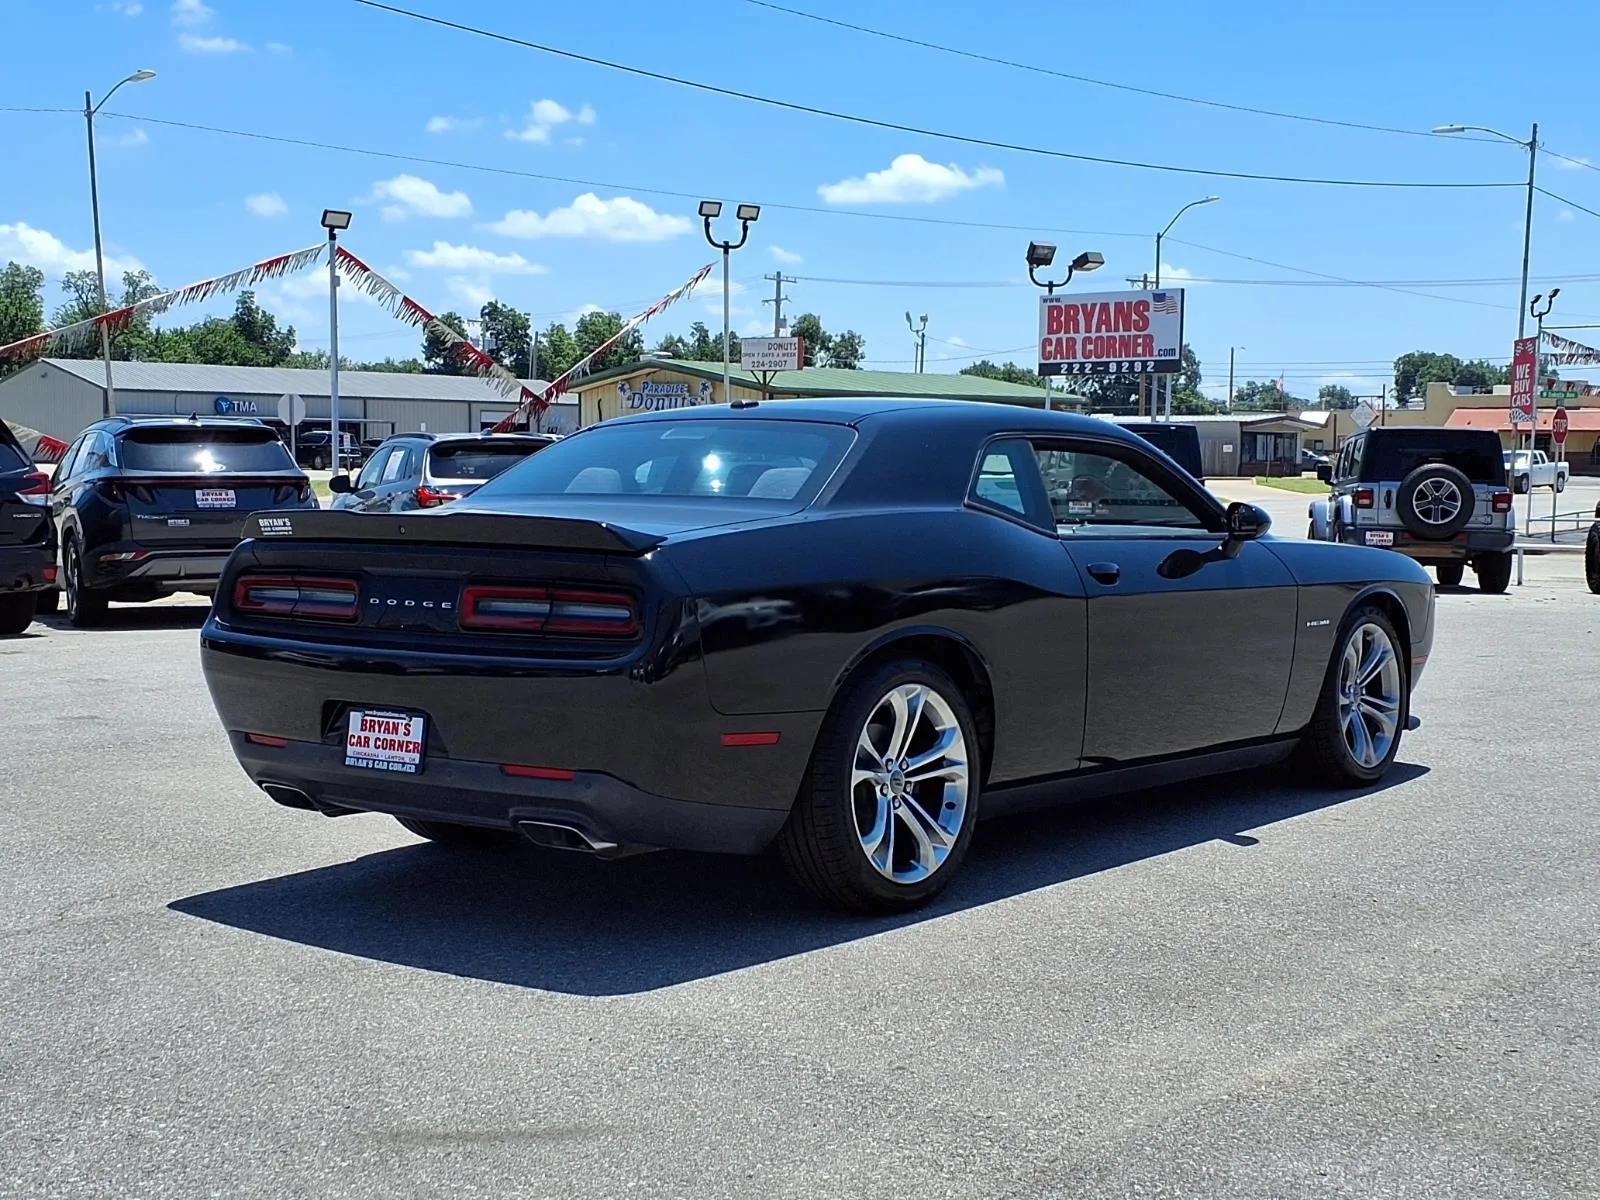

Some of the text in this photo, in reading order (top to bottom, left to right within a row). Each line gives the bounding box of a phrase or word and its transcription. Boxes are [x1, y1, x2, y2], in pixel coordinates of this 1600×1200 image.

[1047, 300, 1150, 335] BRYANS
[767, 342, 797, 350] DONUTS
[1041, 334, 1176, 360] CAR CORNER .com
[751, 360, 788, 368] 224-2907
[1060, 361, 1155, 374] 222-9292
[1516, 364, 1530, 379] WE
[1514, 380, 1530, 394] BUY
[232, 400, 258, 412] TMA
[630, 392, 698, 411] Donuts
[1511, 393, 1531, 407] CARS
[1554, 419, 1568, 432] STOP
[258, 518, 290, 526] BRYAN'S
[370, 598, 452, 609] DODGE
[360, 719, 412, 737] BRYAN'S
[348, 734, 421, 754] CAR CORNER
[345, 757, 373, 768] BRYAN'S
[374, 760, 388, 770] CAR
